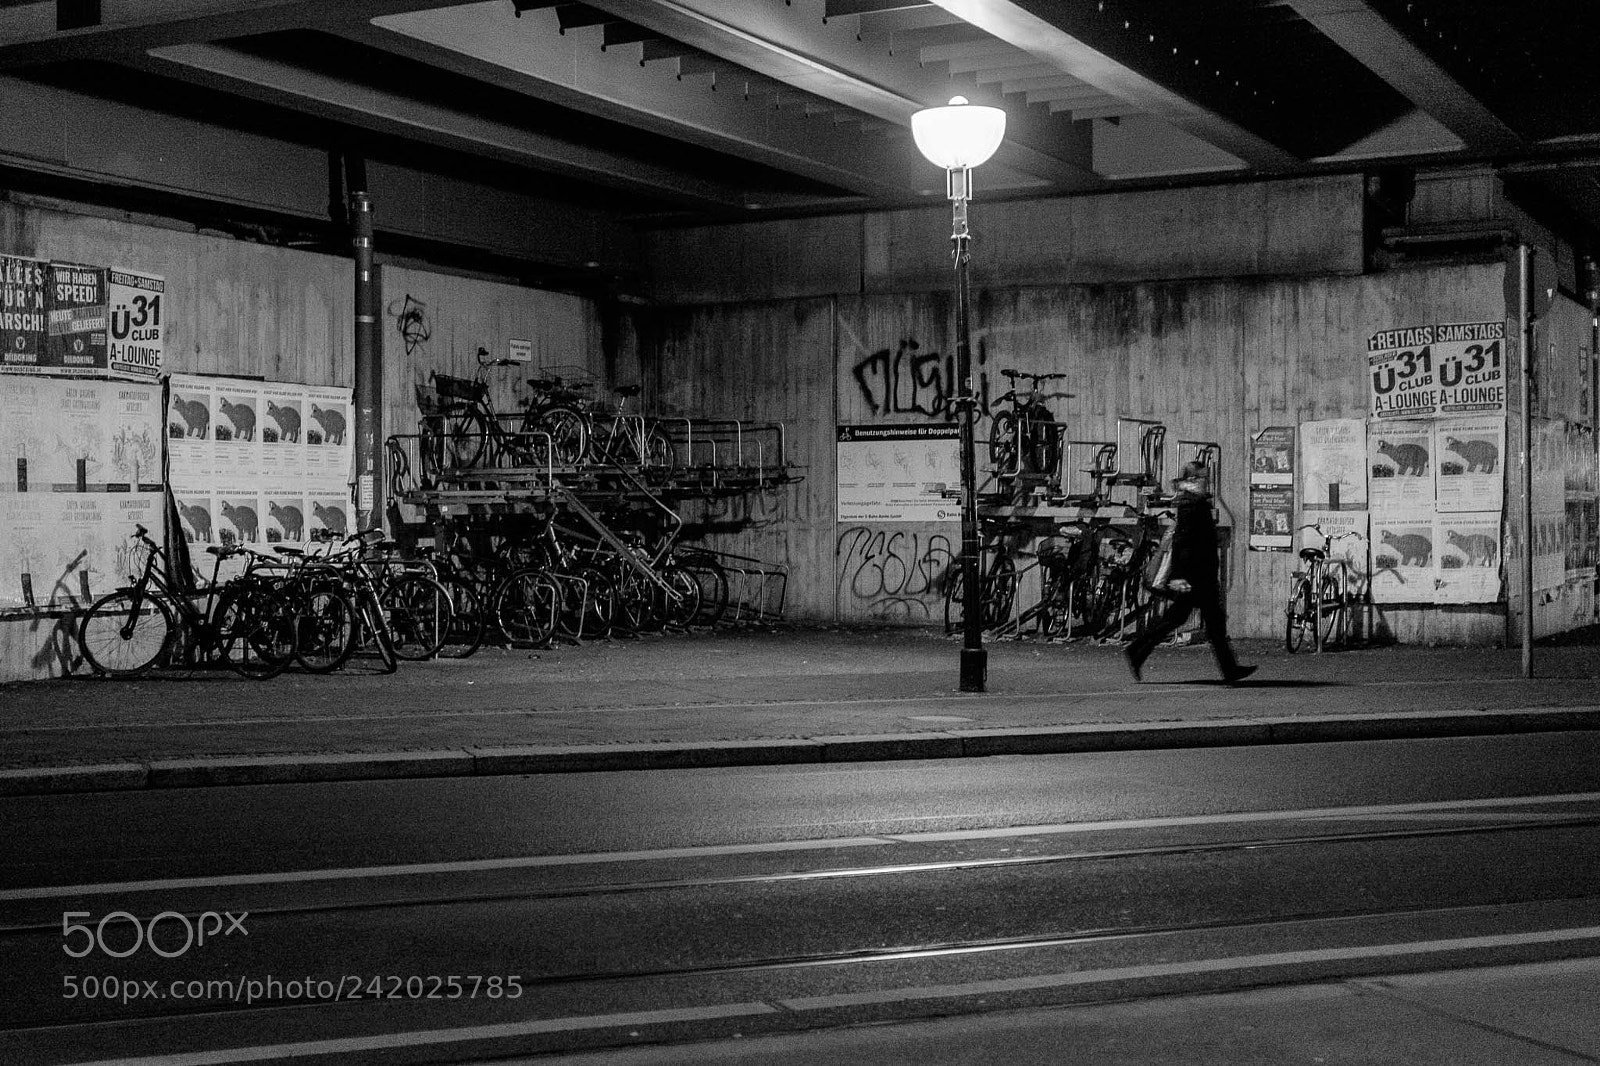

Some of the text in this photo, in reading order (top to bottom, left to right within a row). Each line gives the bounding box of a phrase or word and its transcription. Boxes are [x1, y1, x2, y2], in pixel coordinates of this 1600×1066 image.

[55, 270, 97, 285] WIR HABEN
[0, 284, 43, 308] ÜR'N
[57, 284, 97, 303] SPEED!
[132, 328, 160, 341] CLUB
[1370, 327, 1432, 350] FREITAGS
[1438, 323, 1503, 341] SAMSTAGS
[110, 343, 161, 367] A-LOUNGE
[1399, 375, 1433, 391] CLUB
[1465, 370, 1501, 385] CLUB
[1375, 391, 1438, 411] A-LOUNGE
[1440, 386, 1504, 404] A-LOUNGE
[855, 427, 917, 437] Benutzungshinweise
[918, 427, 927, 435] für
